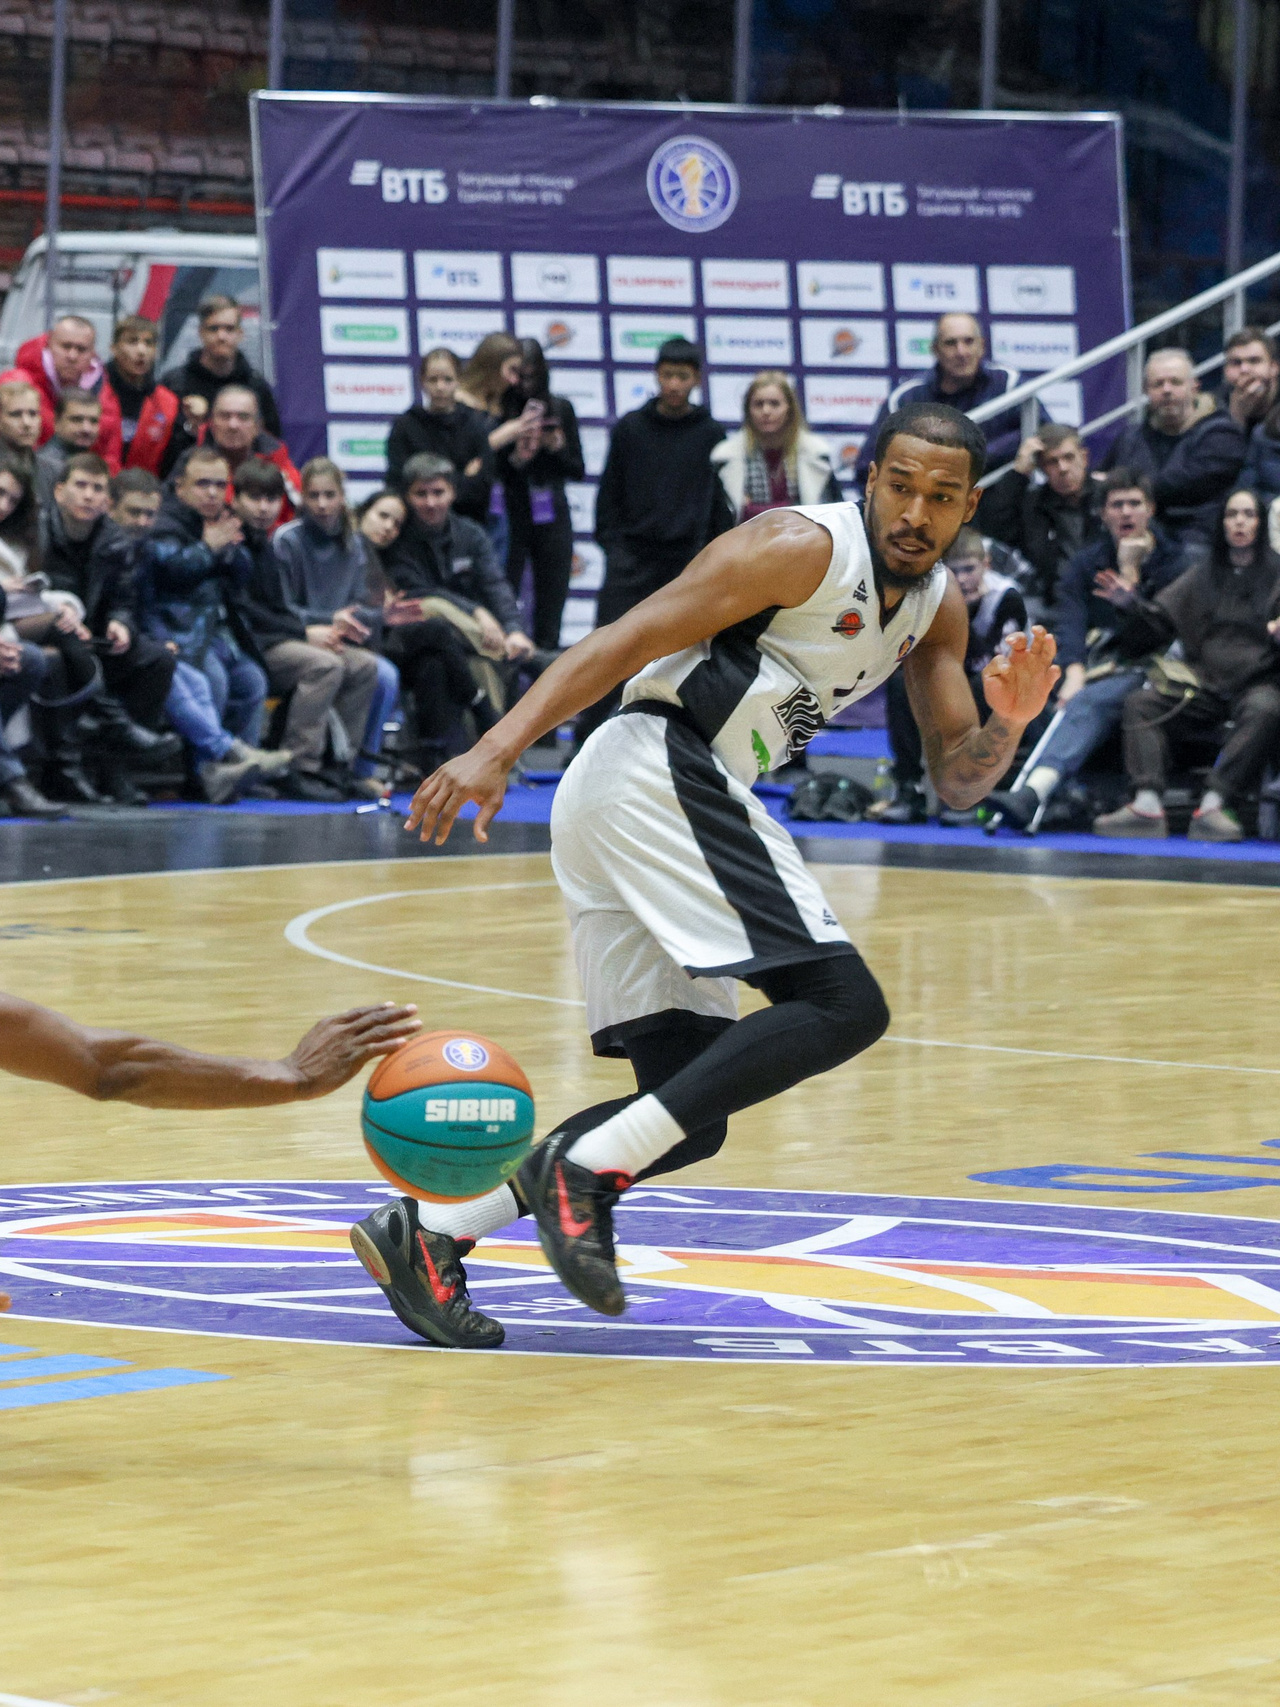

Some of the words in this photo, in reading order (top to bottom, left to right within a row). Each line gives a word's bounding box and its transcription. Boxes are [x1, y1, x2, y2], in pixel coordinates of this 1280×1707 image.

[381, 168, 449, 203] ВТБ
[842, 181, 909, 217] ВТБ
[424, 1098, 516, 1122] SIBUR
